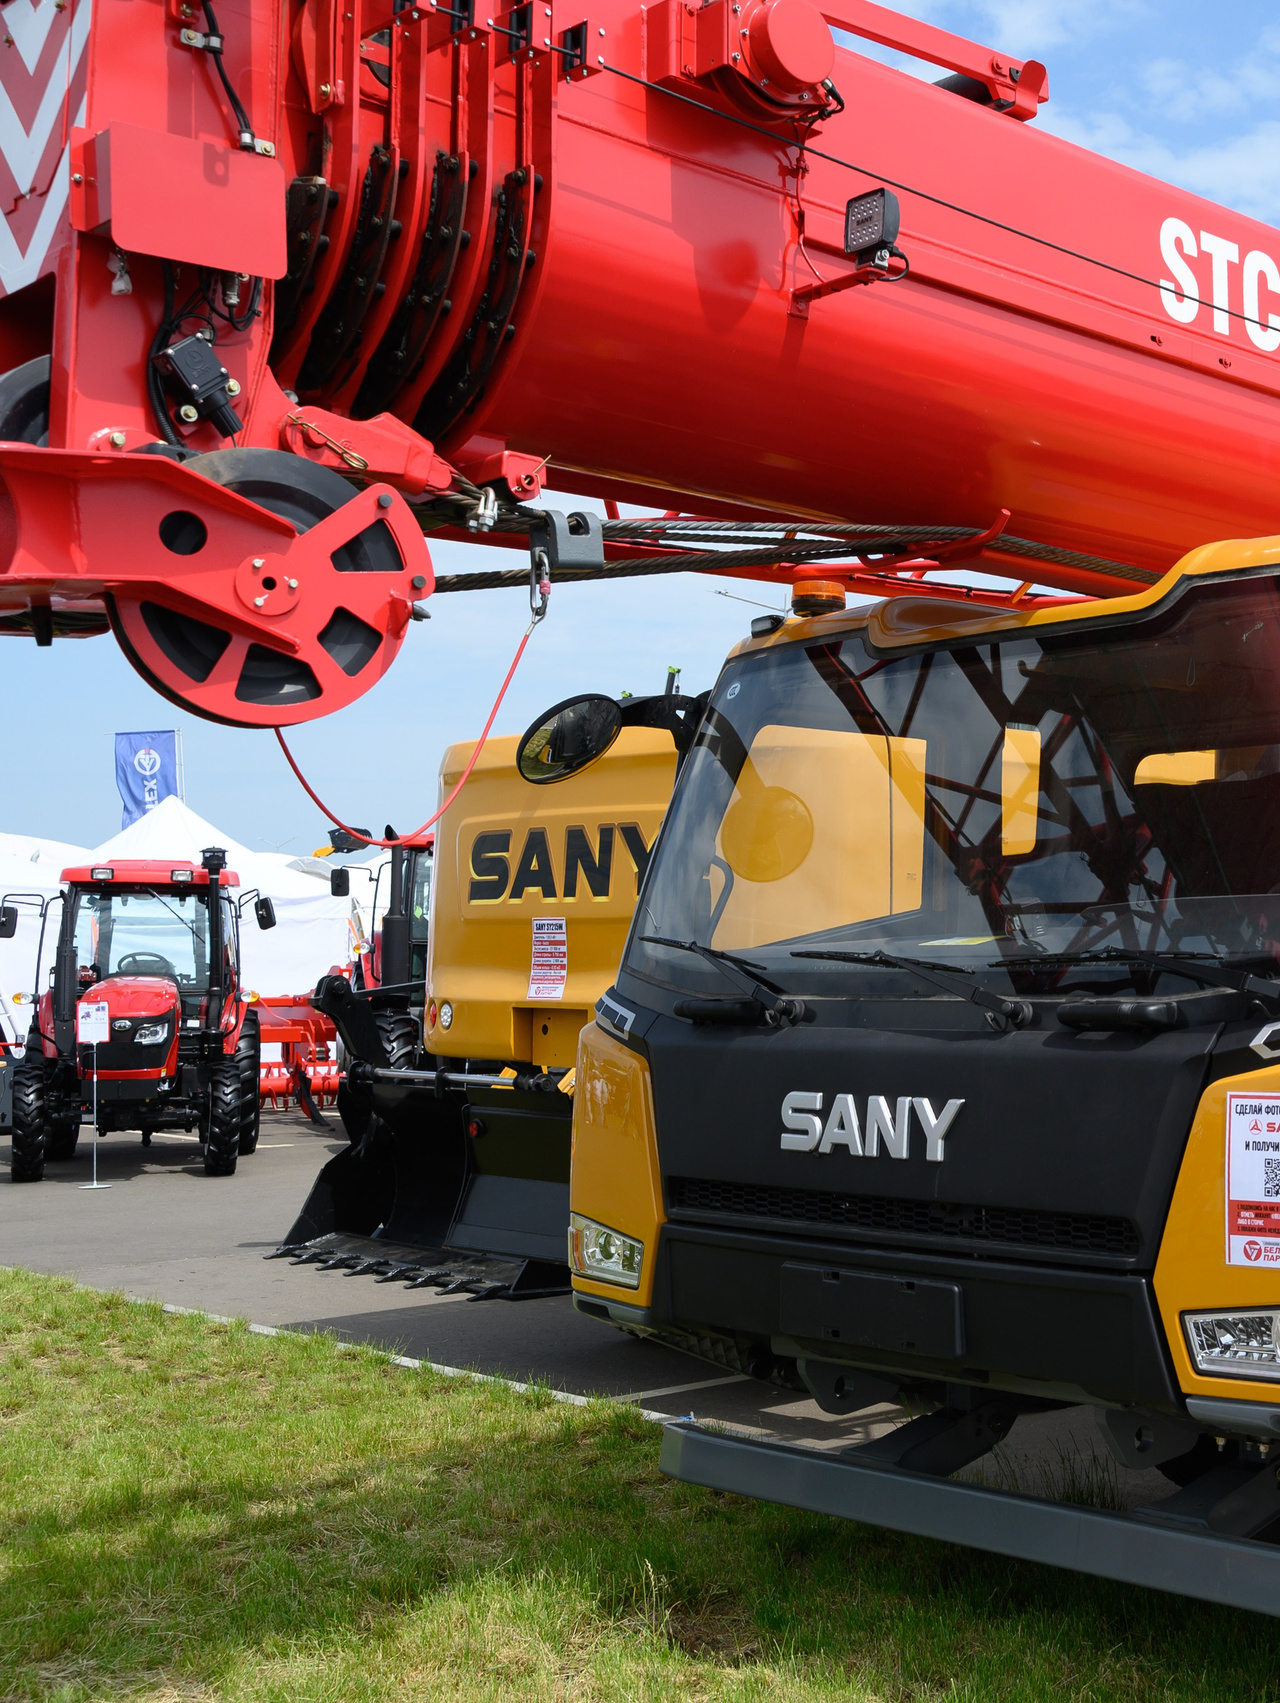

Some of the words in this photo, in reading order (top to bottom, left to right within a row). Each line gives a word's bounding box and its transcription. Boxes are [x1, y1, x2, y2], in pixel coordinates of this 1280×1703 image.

[856, 215, 873, 226] SANY
[468, 824, 662, 904] SANY
[1235, 1103, 1262, 1116] СДЕЛАЙ
[780, 1090, 966, 1162] SANY
[1244, 1141, 1251, 1151] И
[1252, 1141, 1280, 1152] ПОЛУЧИ
